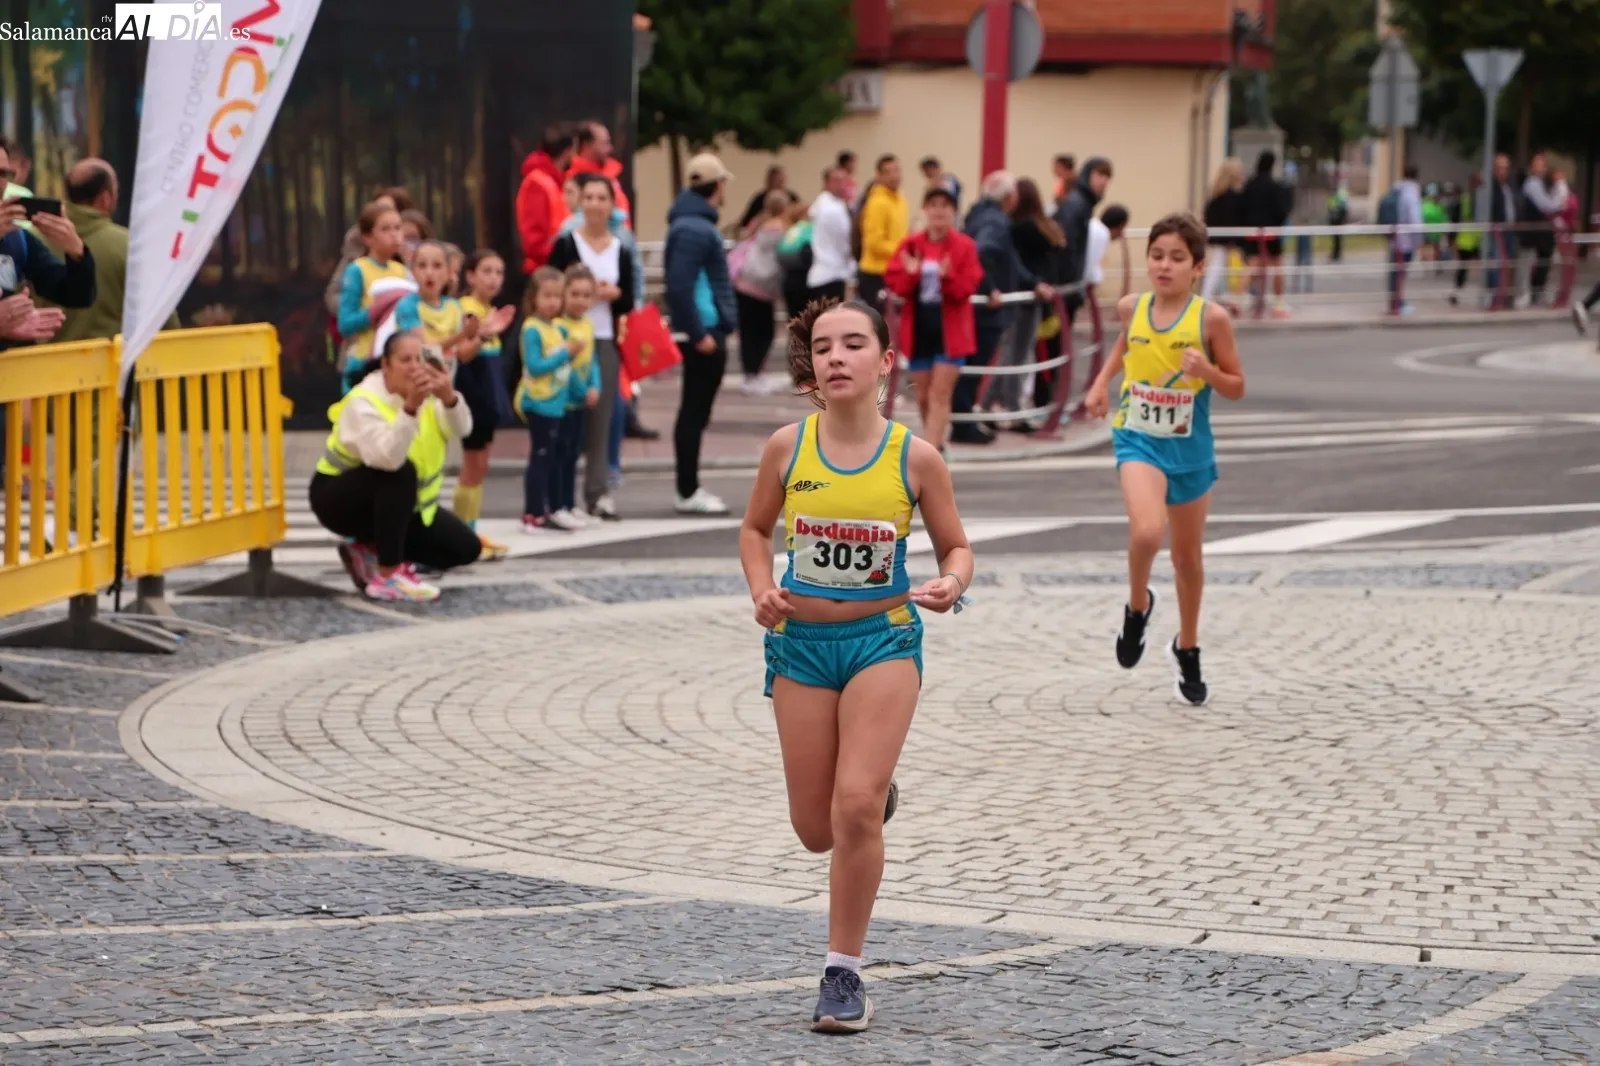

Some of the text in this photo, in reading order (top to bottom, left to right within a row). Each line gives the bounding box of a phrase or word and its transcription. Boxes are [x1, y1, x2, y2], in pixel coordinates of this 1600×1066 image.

[1141, 403, 1176, 425] 311
[796, 518, 895, 543] bedunia
[813, 541, 874, 571] 303
